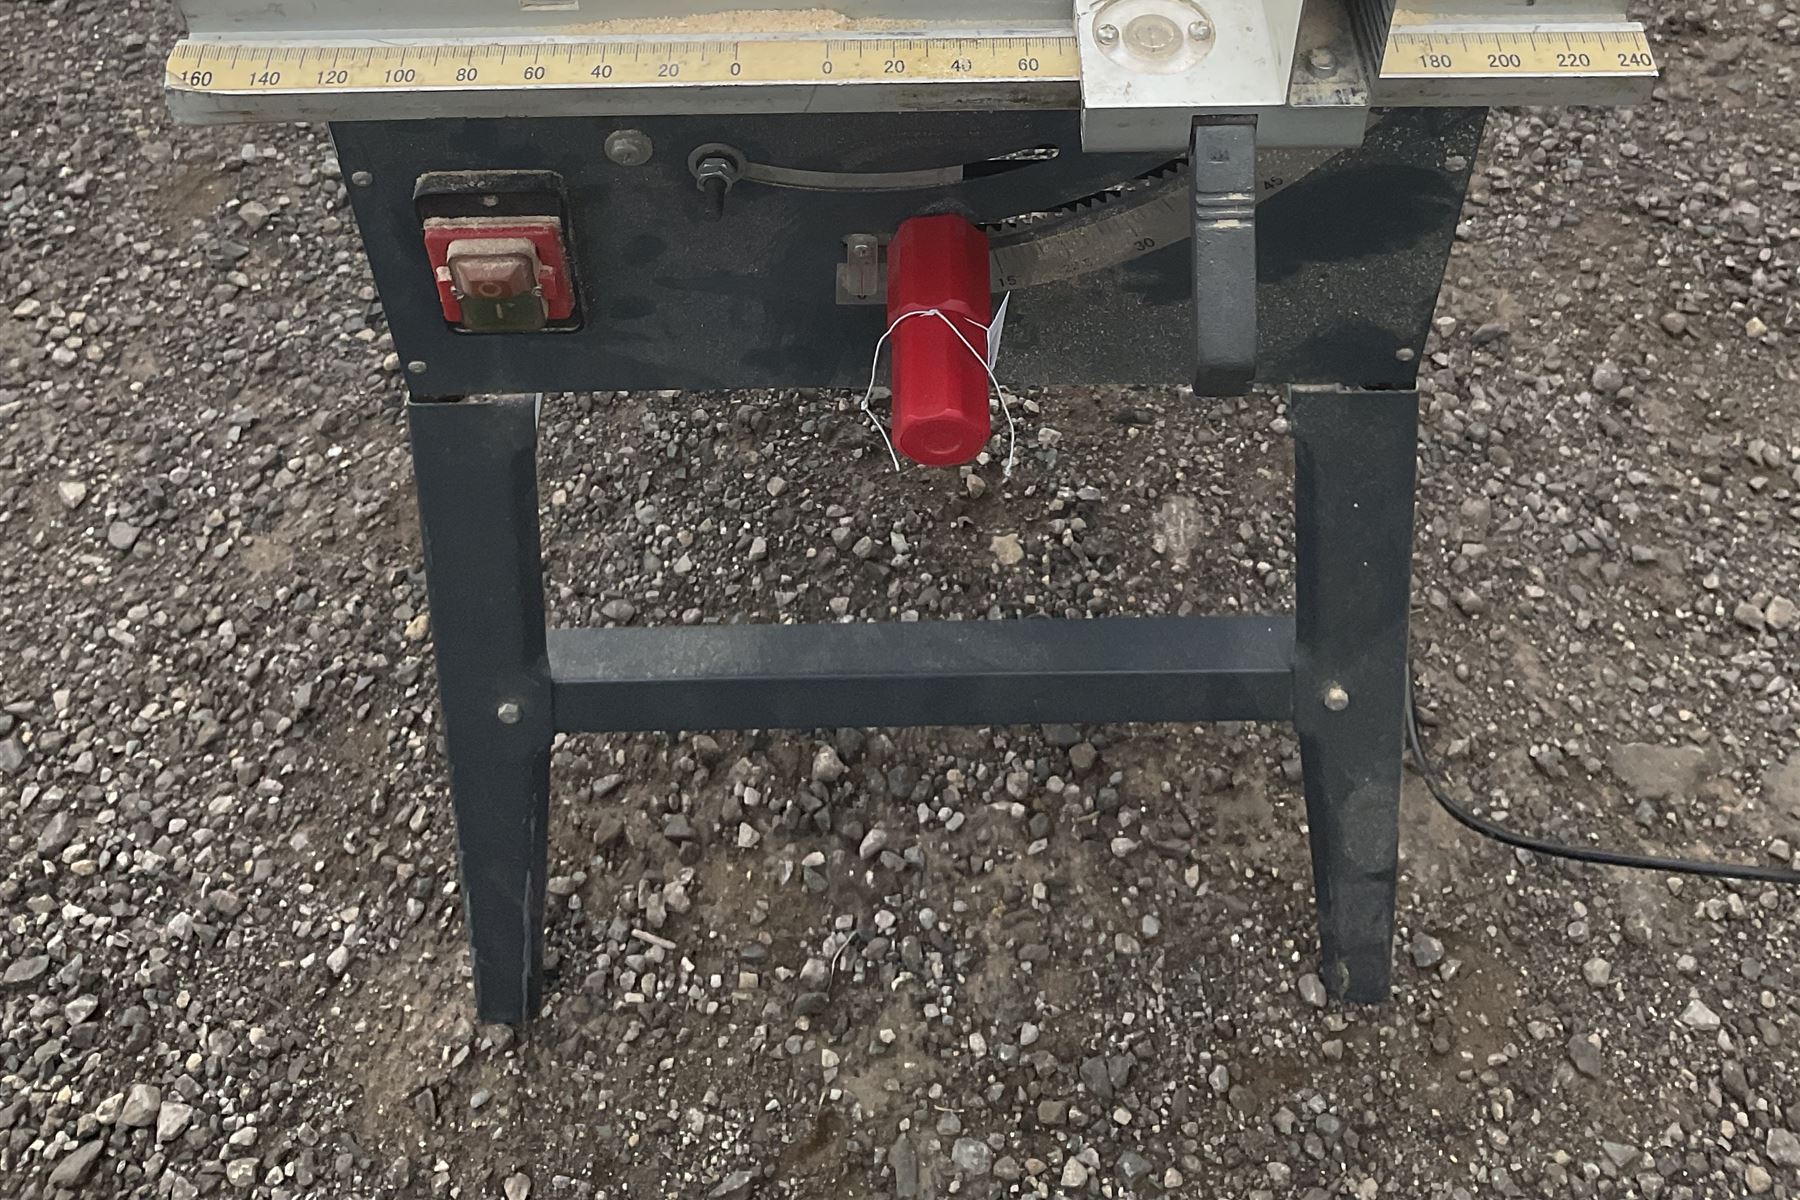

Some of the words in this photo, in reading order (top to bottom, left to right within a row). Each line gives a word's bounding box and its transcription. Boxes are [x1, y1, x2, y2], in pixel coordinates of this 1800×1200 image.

[180, 70, 213, 87] 160
[248, 71, 280, 86] 140
[316, 70, 348, 85] 120
[384, 68, 416, 84] 100
[455, 67, 478, 81] 80
[523, 66, 546, 80] 60
[591, 64, 613, 78] 40
[657, 63, 680, 77] 20
[730, 62, 741, 76] 0
[822, 61, 833, 74] 0
[884, 60, 905, 73] 20
[950, 58, 972, 72] 40
[1018, 58, 1040, 71] 60
[1419, 54, 1453, 68] 180
[1487, 54, 1521, 68] 200
[1556, 53, 1591, 67] 220
[1617, 53, 1652, 67] 240
[999, 275, 1017, 287] 15
[1133, 237, 1155, 251] 30
[1263, 176, 1284, 190] 45
